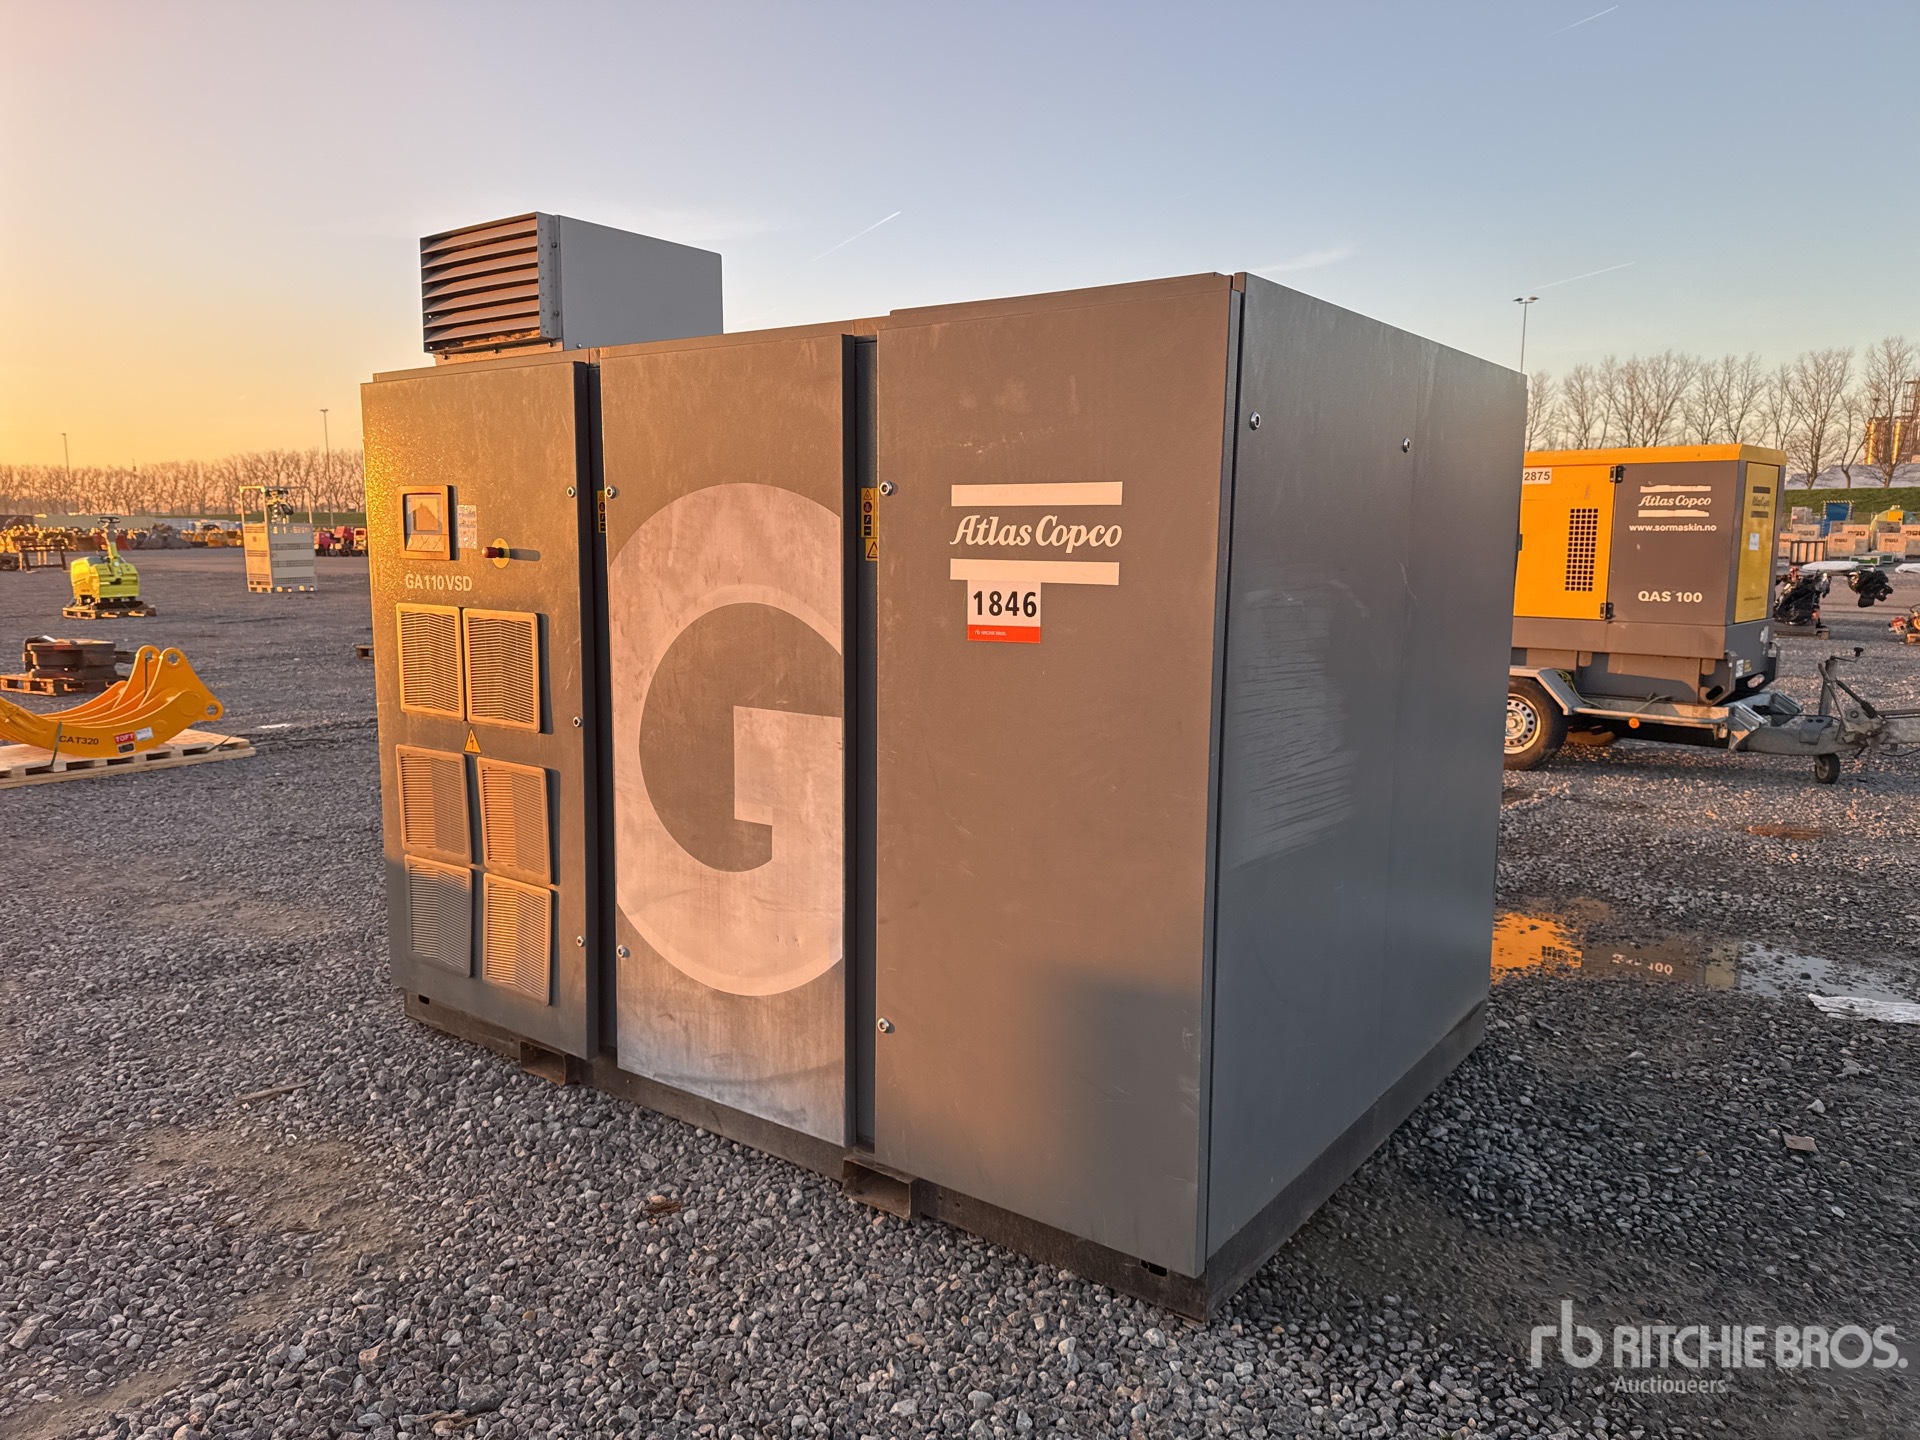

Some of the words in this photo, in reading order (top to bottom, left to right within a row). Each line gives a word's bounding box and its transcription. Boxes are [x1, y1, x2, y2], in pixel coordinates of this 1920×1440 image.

[1524, 471, 1551, 481] 2875
[1638, 495, 1675, 506] Atlas
[1675, 495, 1712, 508] Copco
[950, 514, 1031, 547] Atlas
[1035, 514, 1123, 553] Copco
[1629, 523, 1717, 532] www.sormaskin.no
[1638, 590, 1672, 602] QAS
[1675, 591, 1703, 602] 100
[973, 590, 1037, 617] 1846
[59, 735, 99, 745] CAT320
